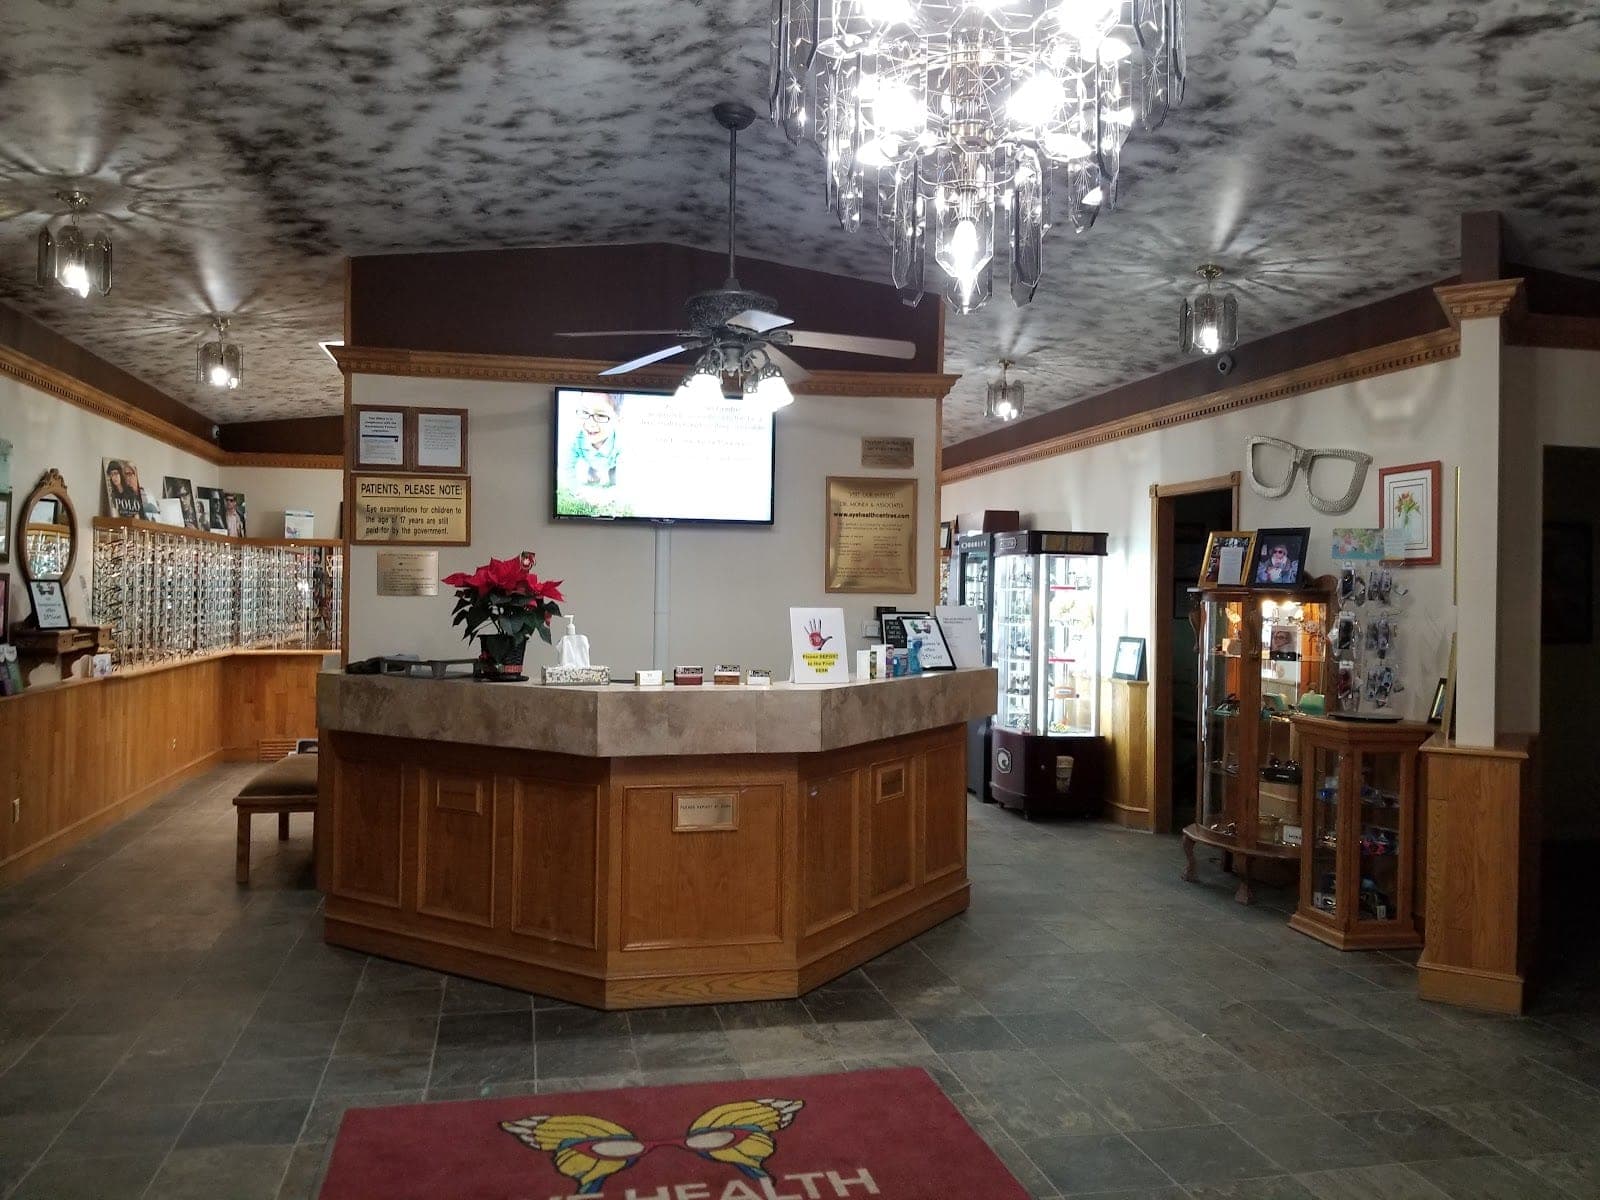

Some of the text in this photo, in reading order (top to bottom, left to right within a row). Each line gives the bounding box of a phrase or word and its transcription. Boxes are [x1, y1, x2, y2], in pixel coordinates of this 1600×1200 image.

[361, 483, 463, 496] PATIENTS, PLEASE NOTE:
[115, 498, 140, 511] POLO
[366, 504, 462, 515] Eye examinations for children to
[365, 515, 374, 524] the
[378, 516, 389, 525] age
[390, 515, 398, 524] of
[408, 517, 424, 526] years
[438, 516, 449, 525] still
[365, 526, 449, 536] paid for by the government.
